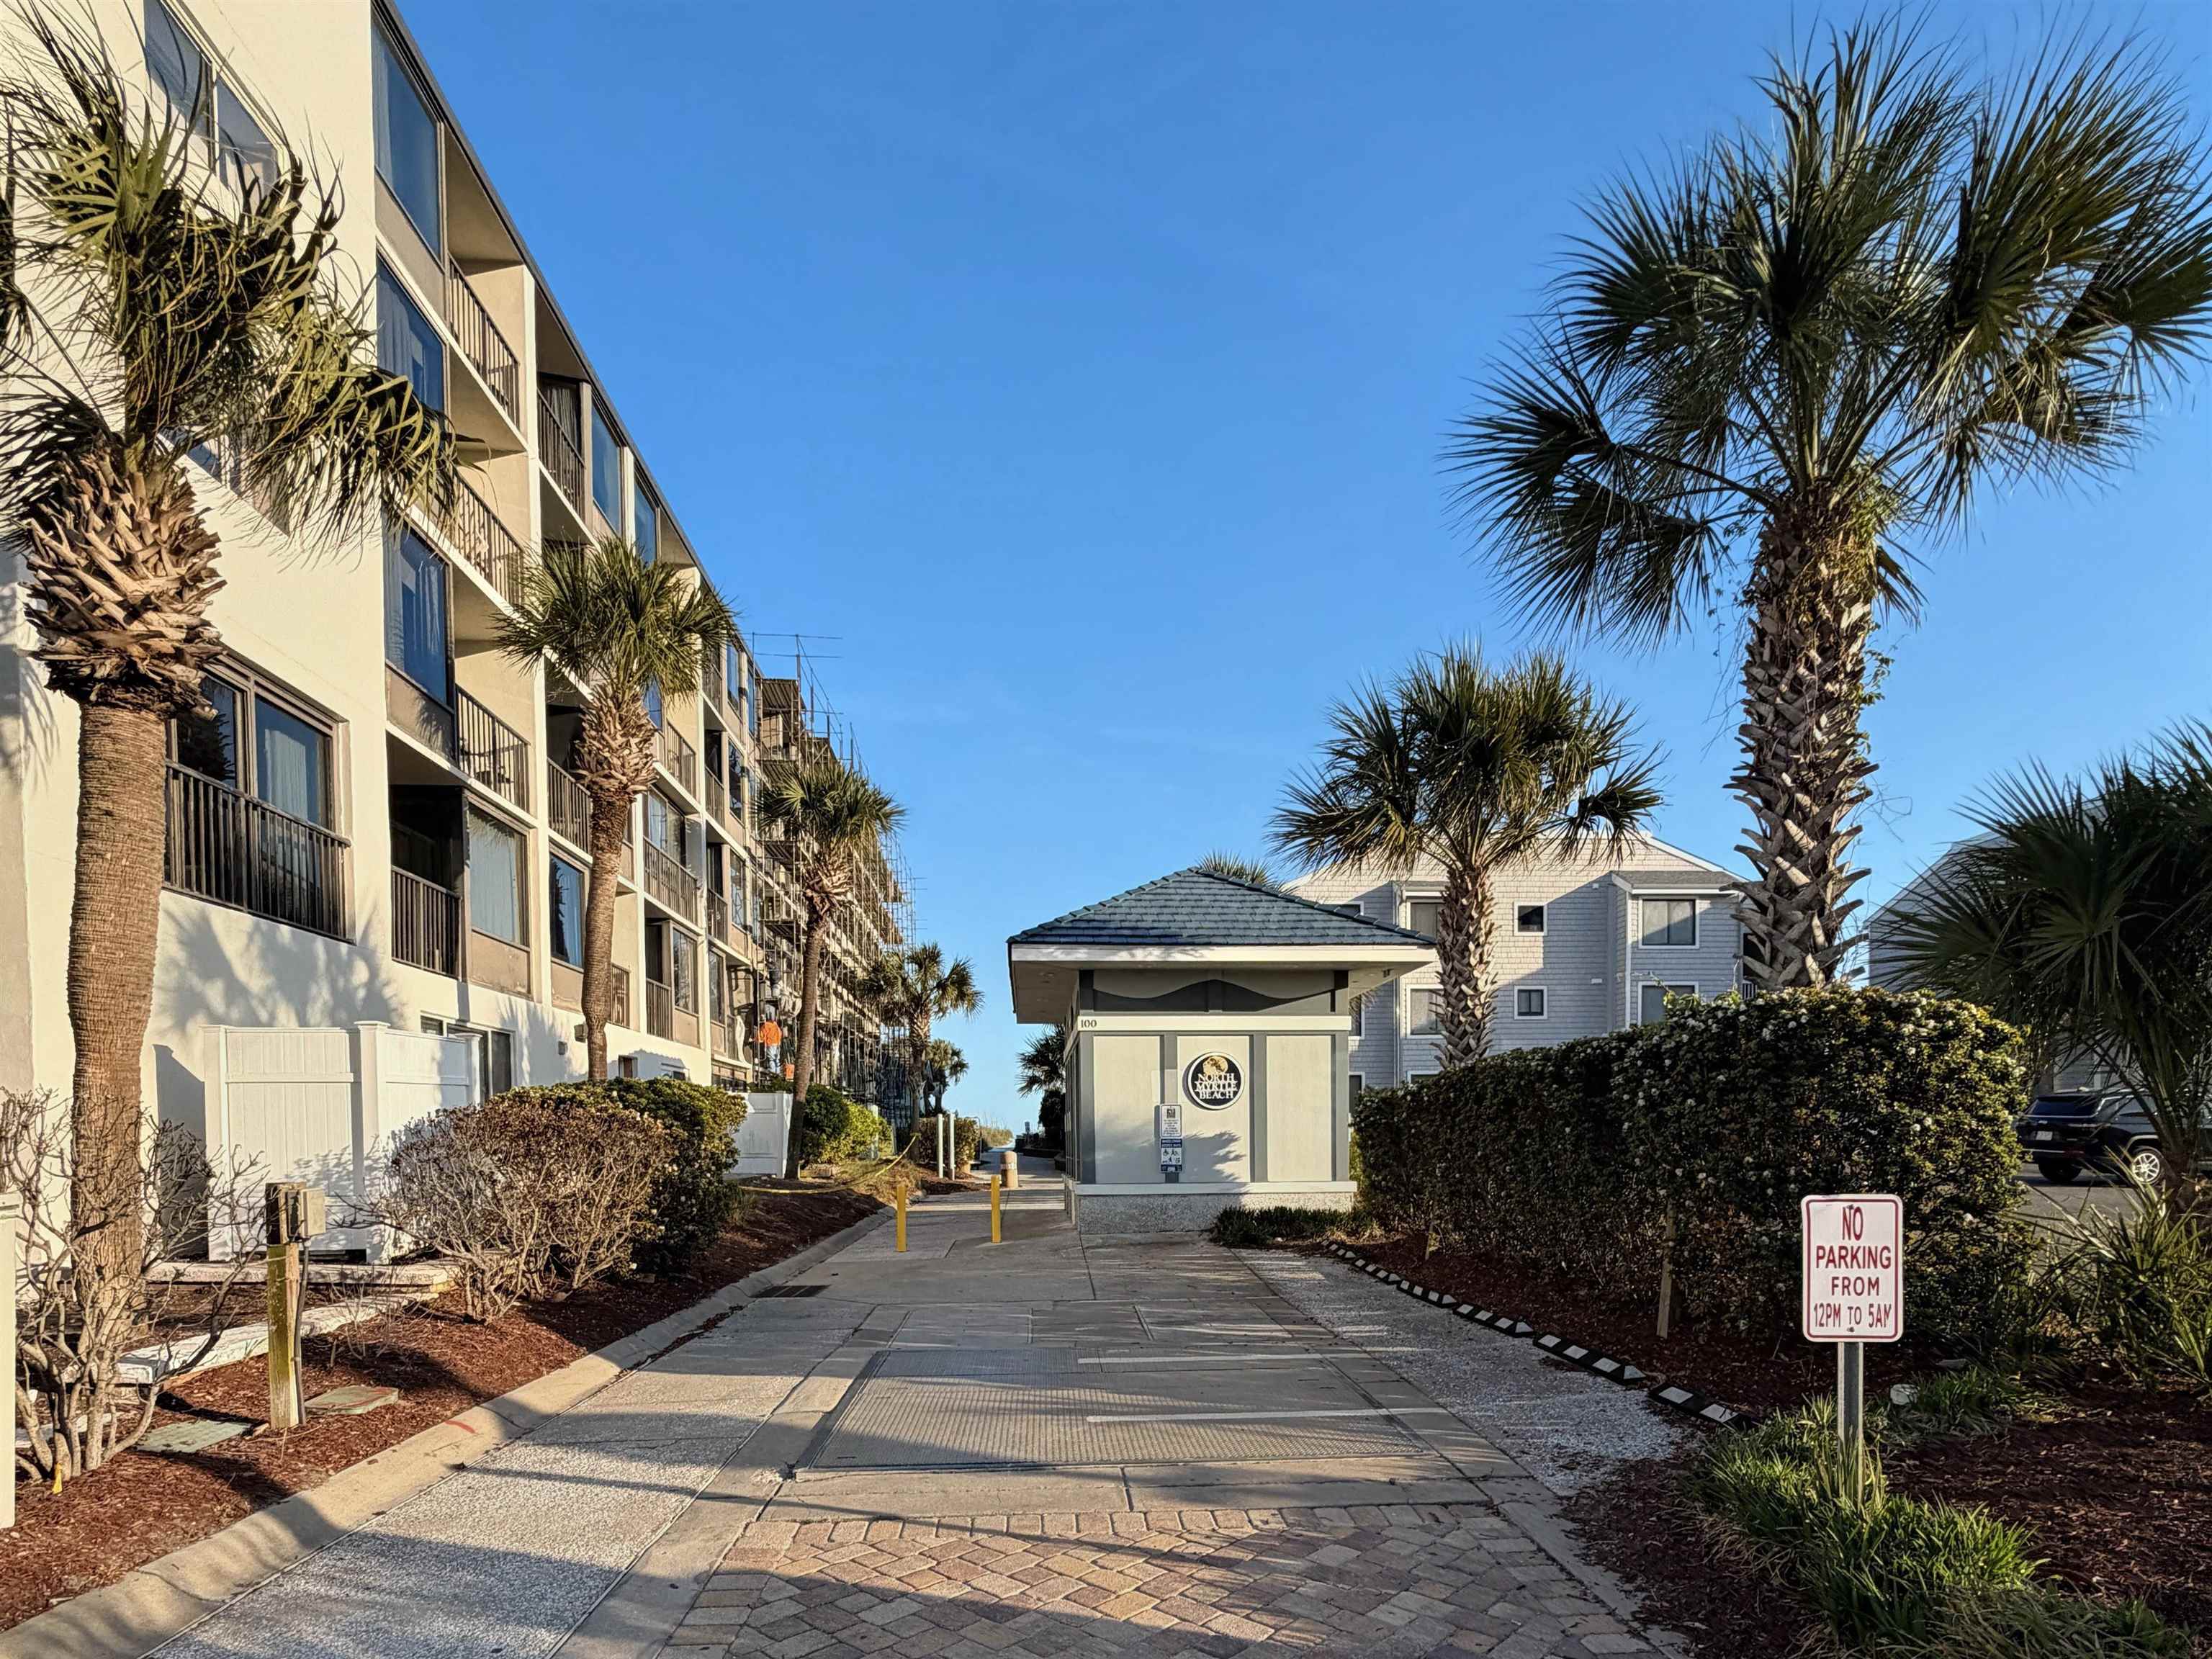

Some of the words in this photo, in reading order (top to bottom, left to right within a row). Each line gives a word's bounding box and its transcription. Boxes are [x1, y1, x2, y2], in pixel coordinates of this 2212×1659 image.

[1081, 1019, 1097, 1028] 100
[1197, 1073, 1234, 1083] NORTH
[1195, 1081, 1238, 1092] MYRTLE
[1199, 1090, 1233, 1100] BEACH
[1842, 1206, 1863, 1241] NO
[1815, 1245, 1892, 1269] PARKING
[1831, 1276, 1879, 1296] FROM
[1814, 1303, 1841, 1328] 12PM
[1847, 1306, 1862, 1325] TO
[1868, 1303, 1892, 1328] 5AM
